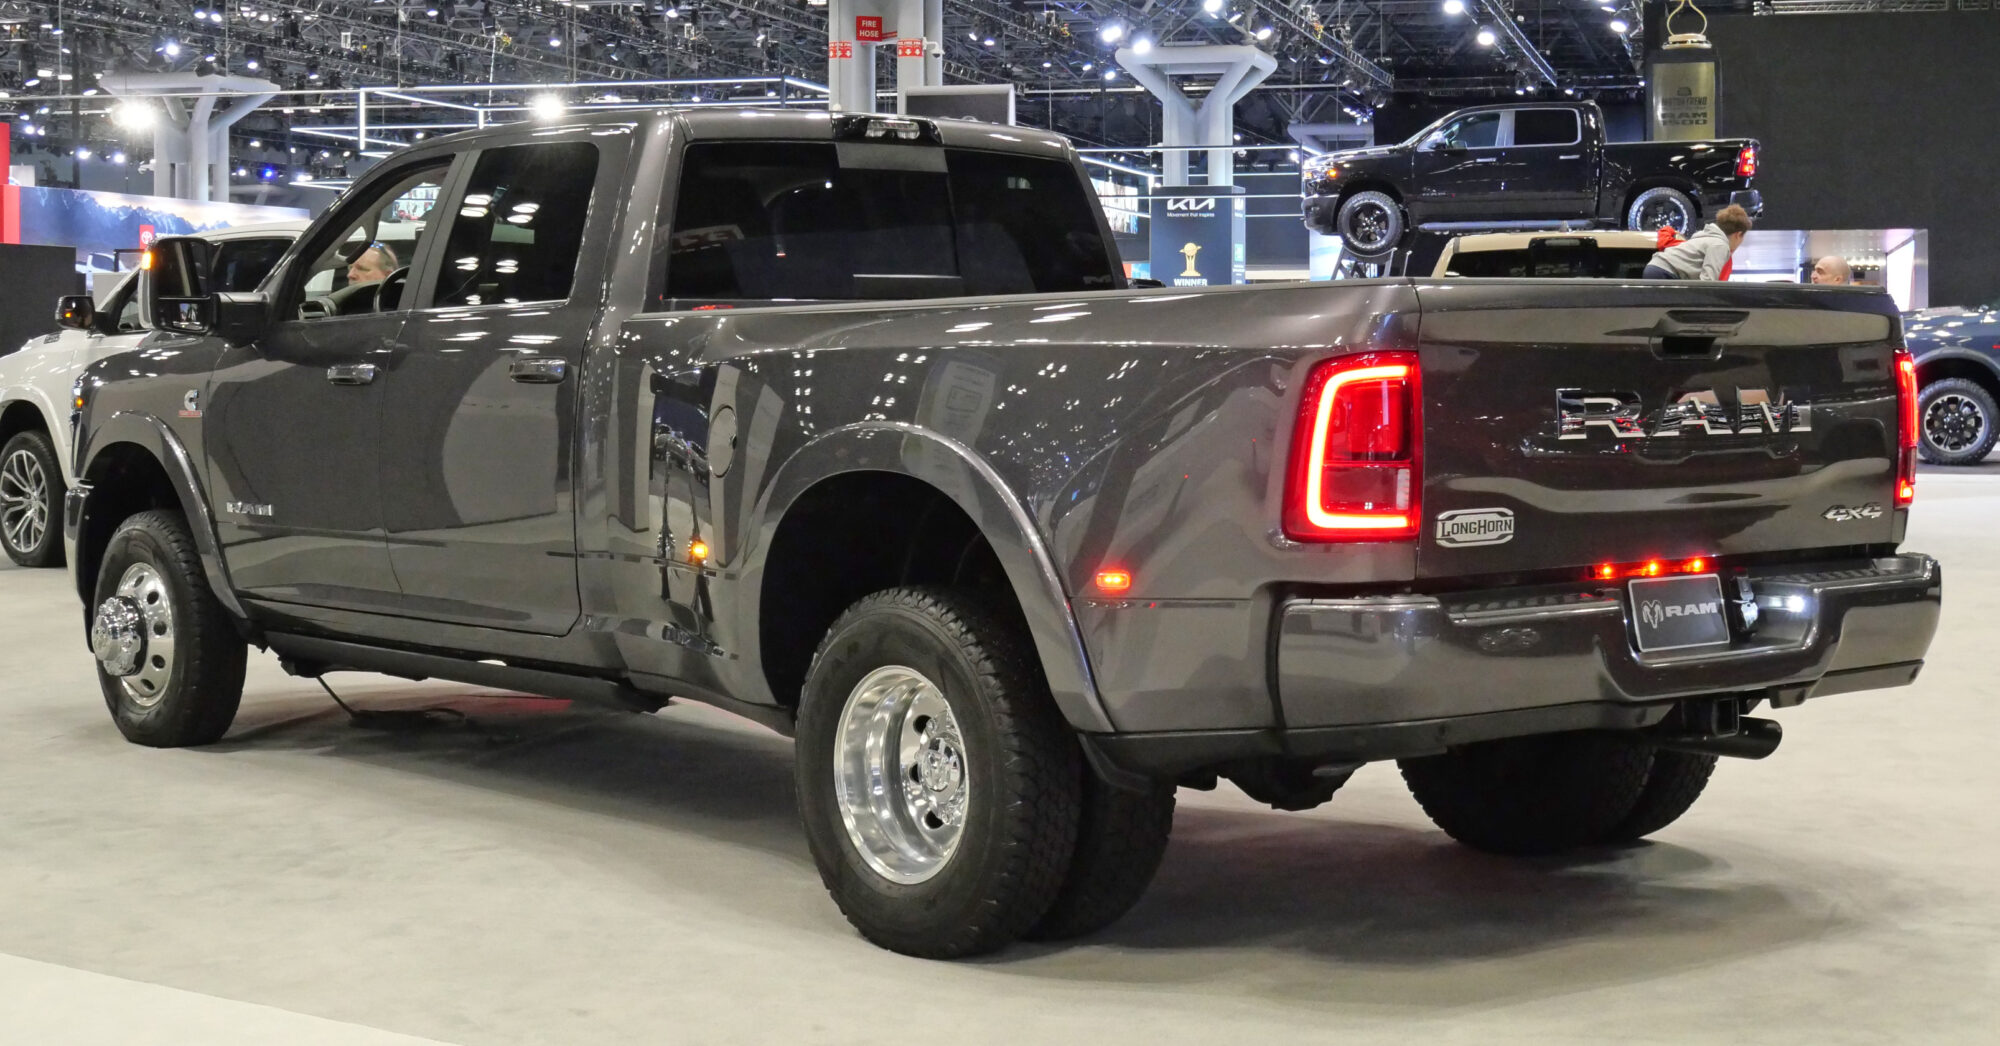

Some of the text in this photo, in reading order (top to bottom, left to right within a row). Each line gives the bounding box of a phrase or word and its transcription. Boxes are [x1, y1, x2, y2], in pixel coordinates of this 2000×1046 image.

[1167, 198, 1215, 210] KIA
[1173, 279, 1208, 287] WINNER
[1556, 387, 1812, 440] RAM
[226, 501, 272, 516] RAM
[1665, 602, 1718, 617] RAM
